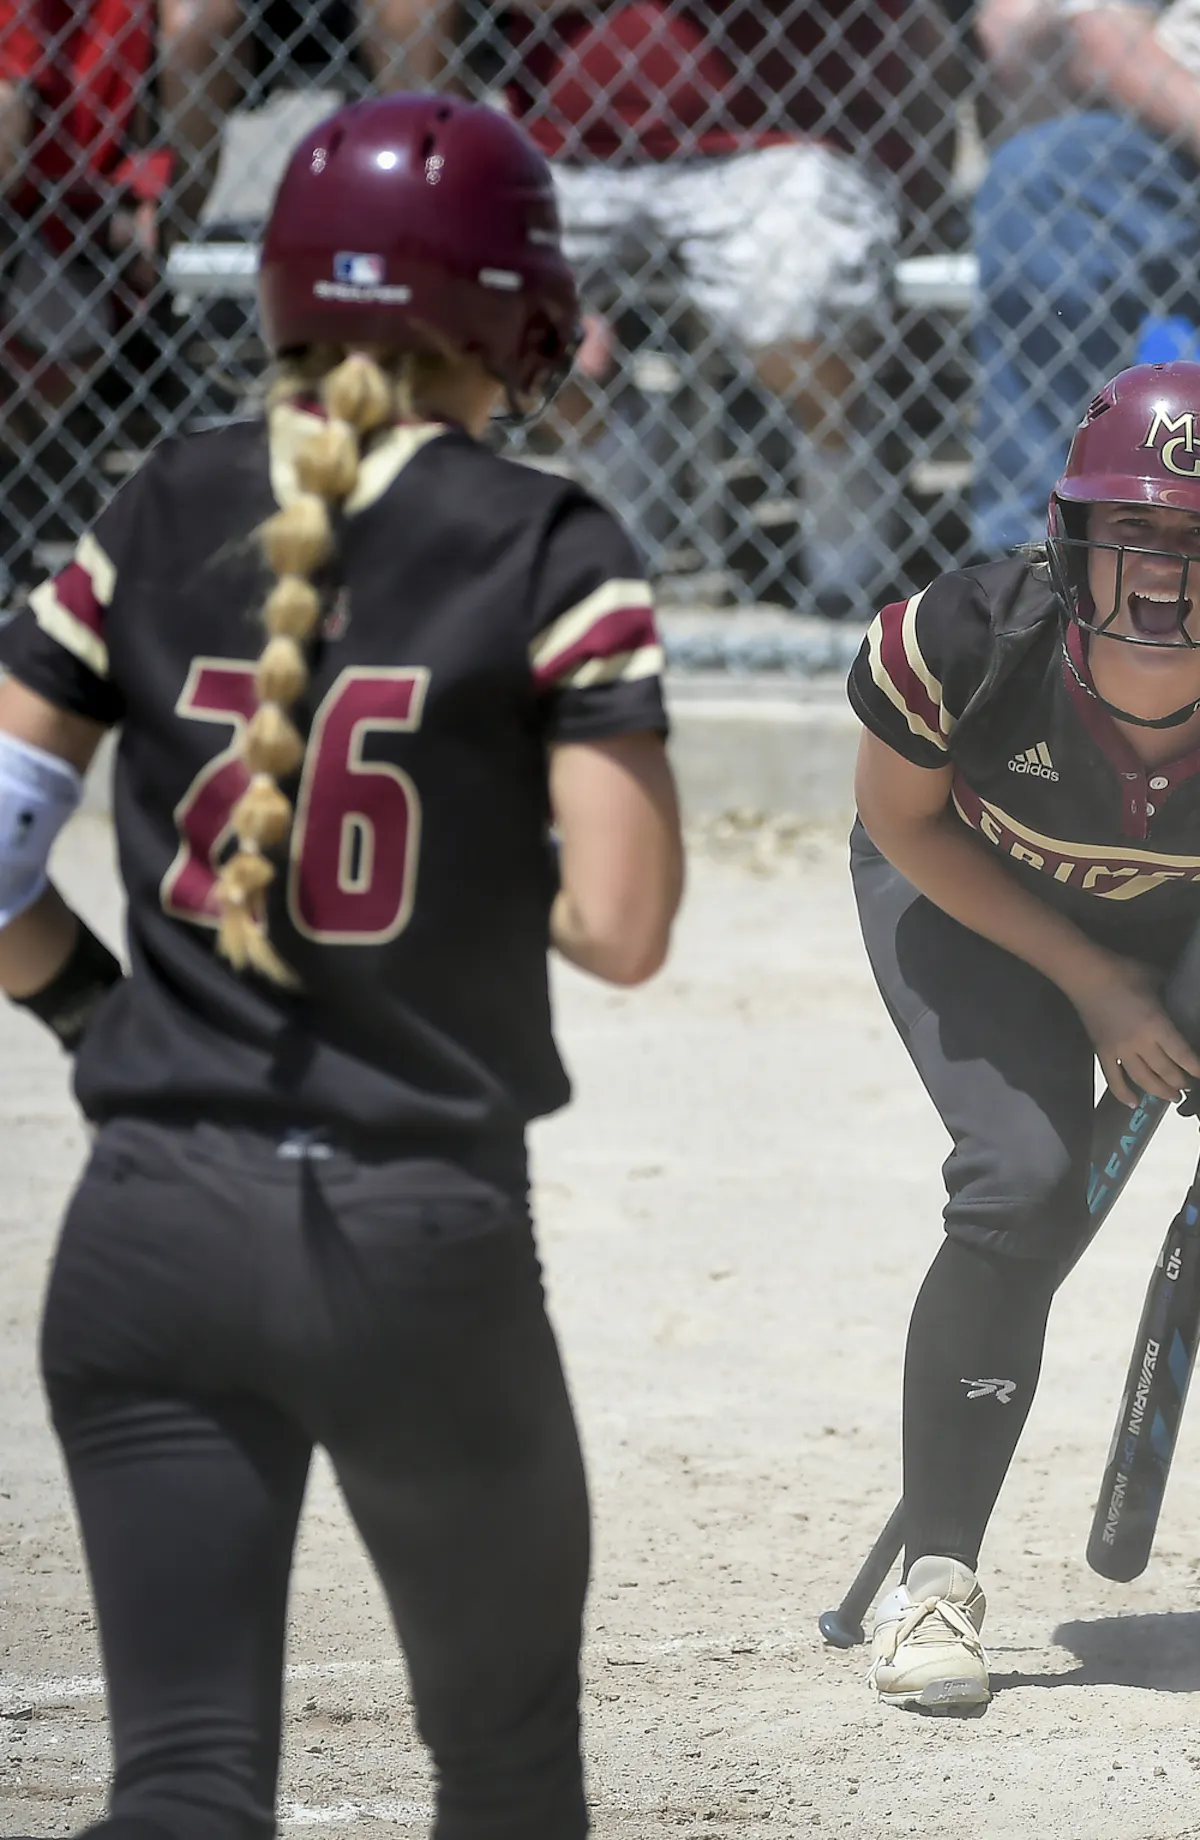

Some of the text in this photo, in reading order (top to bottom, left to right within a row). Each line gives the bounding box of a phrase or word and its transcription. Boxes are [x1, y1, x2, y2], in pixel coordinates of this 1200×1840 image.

[159, 655, 431, 945] 26
[1007, 759, 1060, 782] adidas
[1128, 1338, 1160, 1435] DEMARINI
[1102, 1472, 1129, 1546] INSANE
